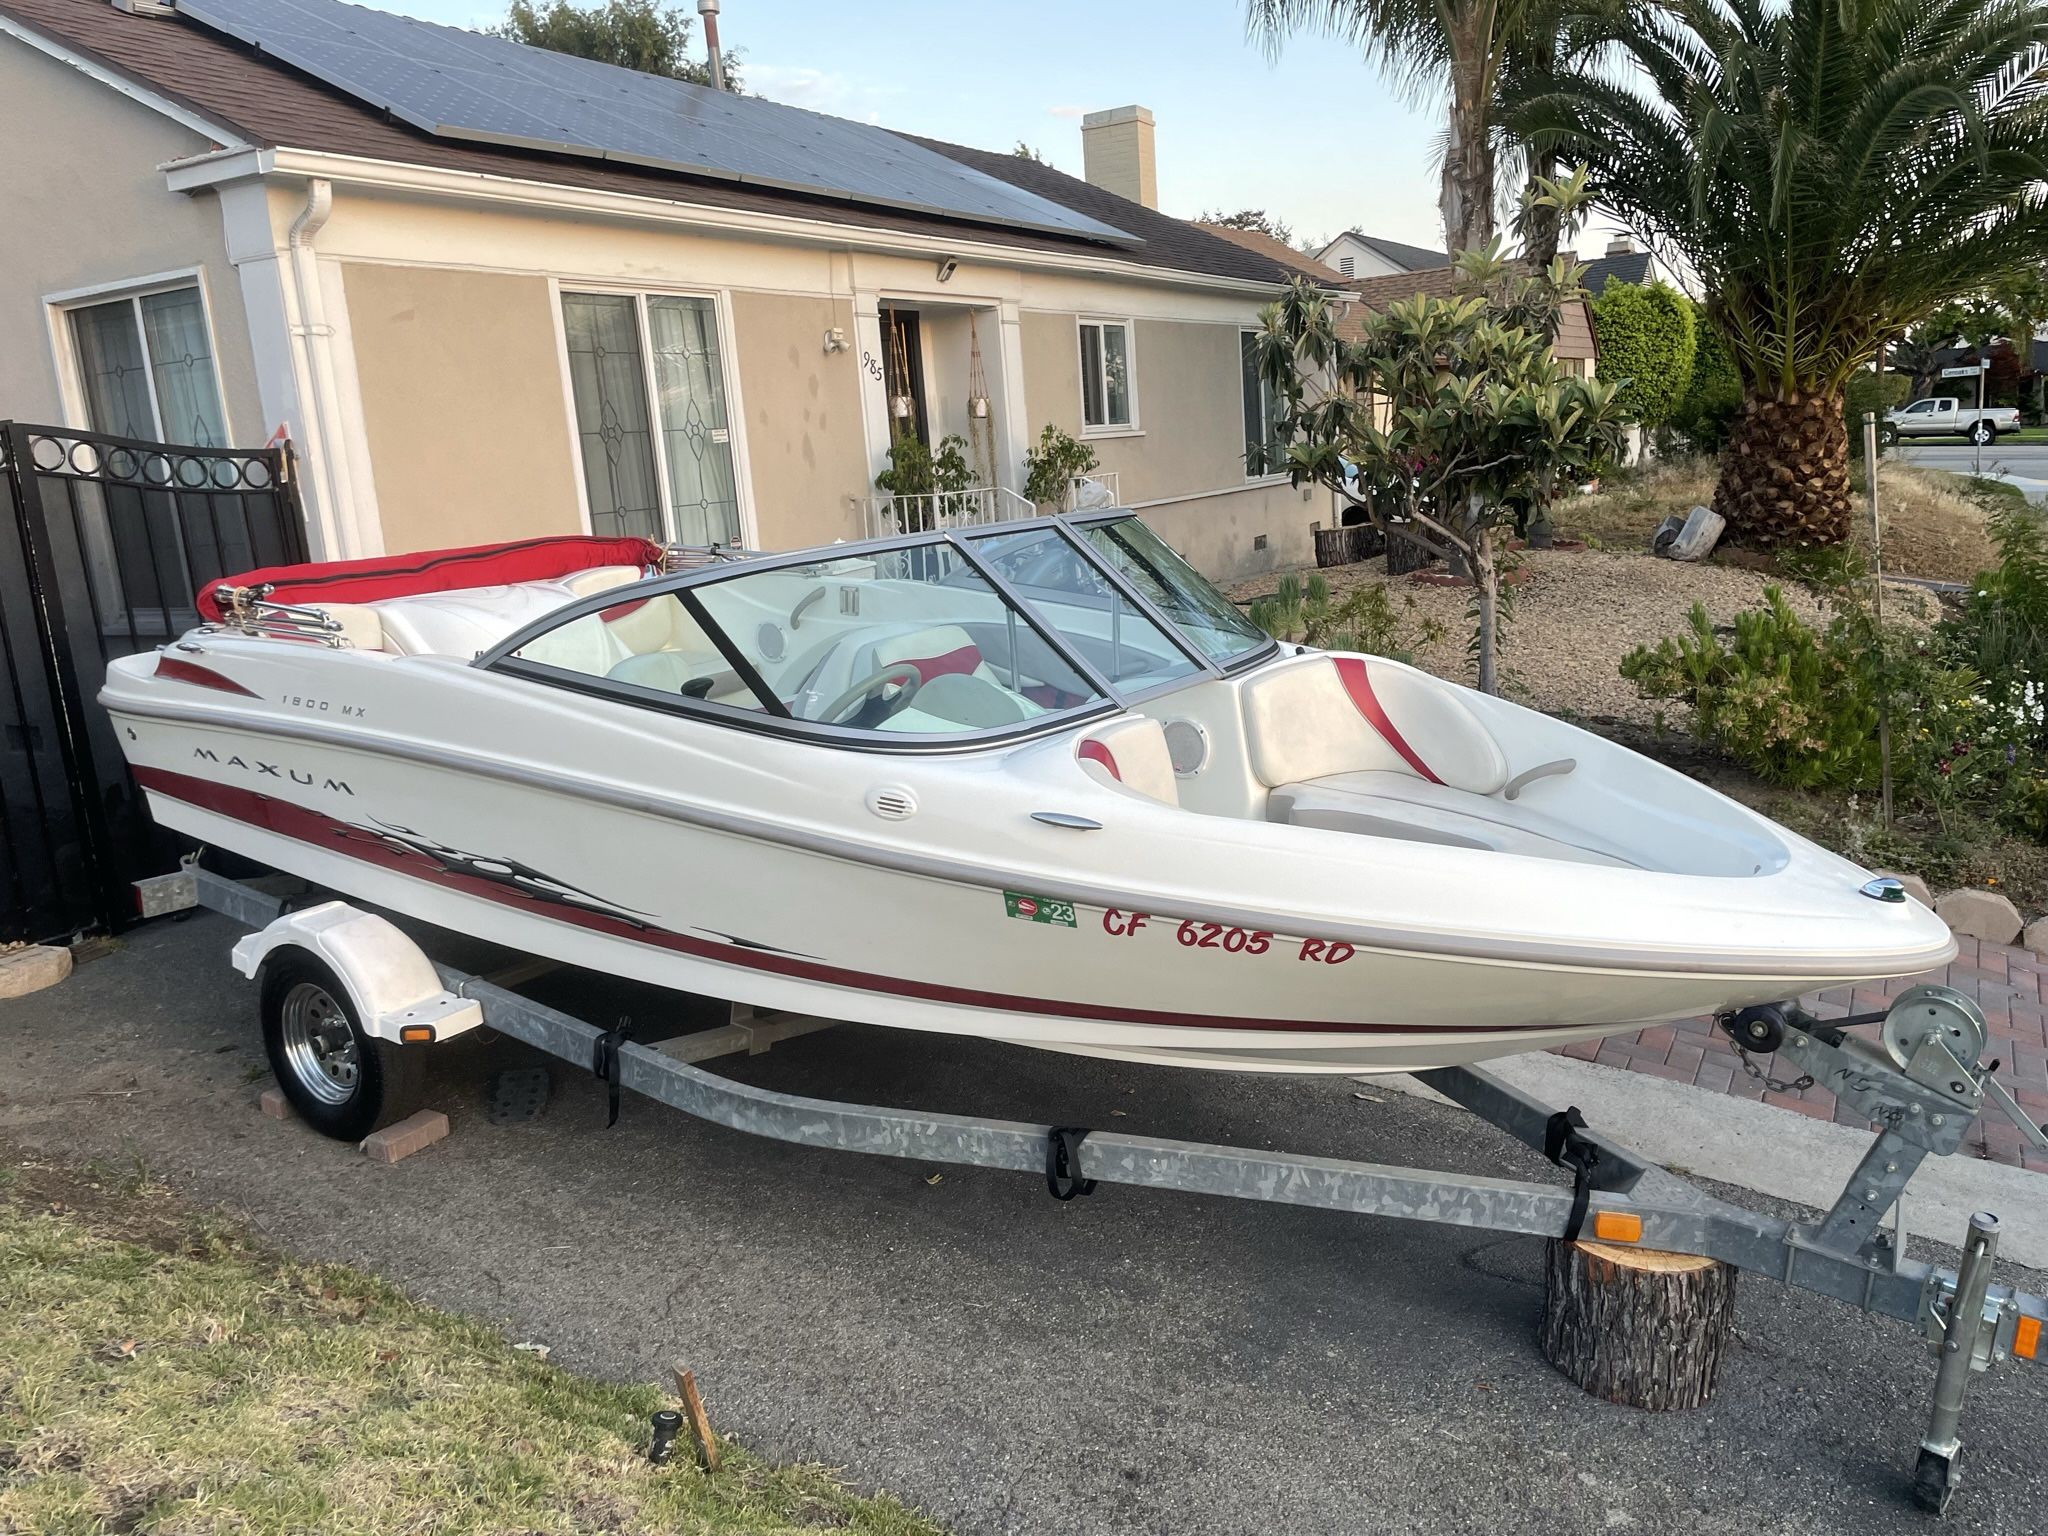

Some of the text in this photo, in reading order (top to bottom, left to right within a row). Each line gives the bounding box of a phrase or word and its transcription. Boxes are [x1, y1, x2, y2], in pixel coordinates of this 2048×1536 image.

[863, 351, 883, 381] 985
[282, 695, 366, 718] 1800 MX
[193, 748, 355, 796] MAXUM
[1050, 903, 1076, 922] 23
[1103, 908, 1355, 965] CF 6205 RD
